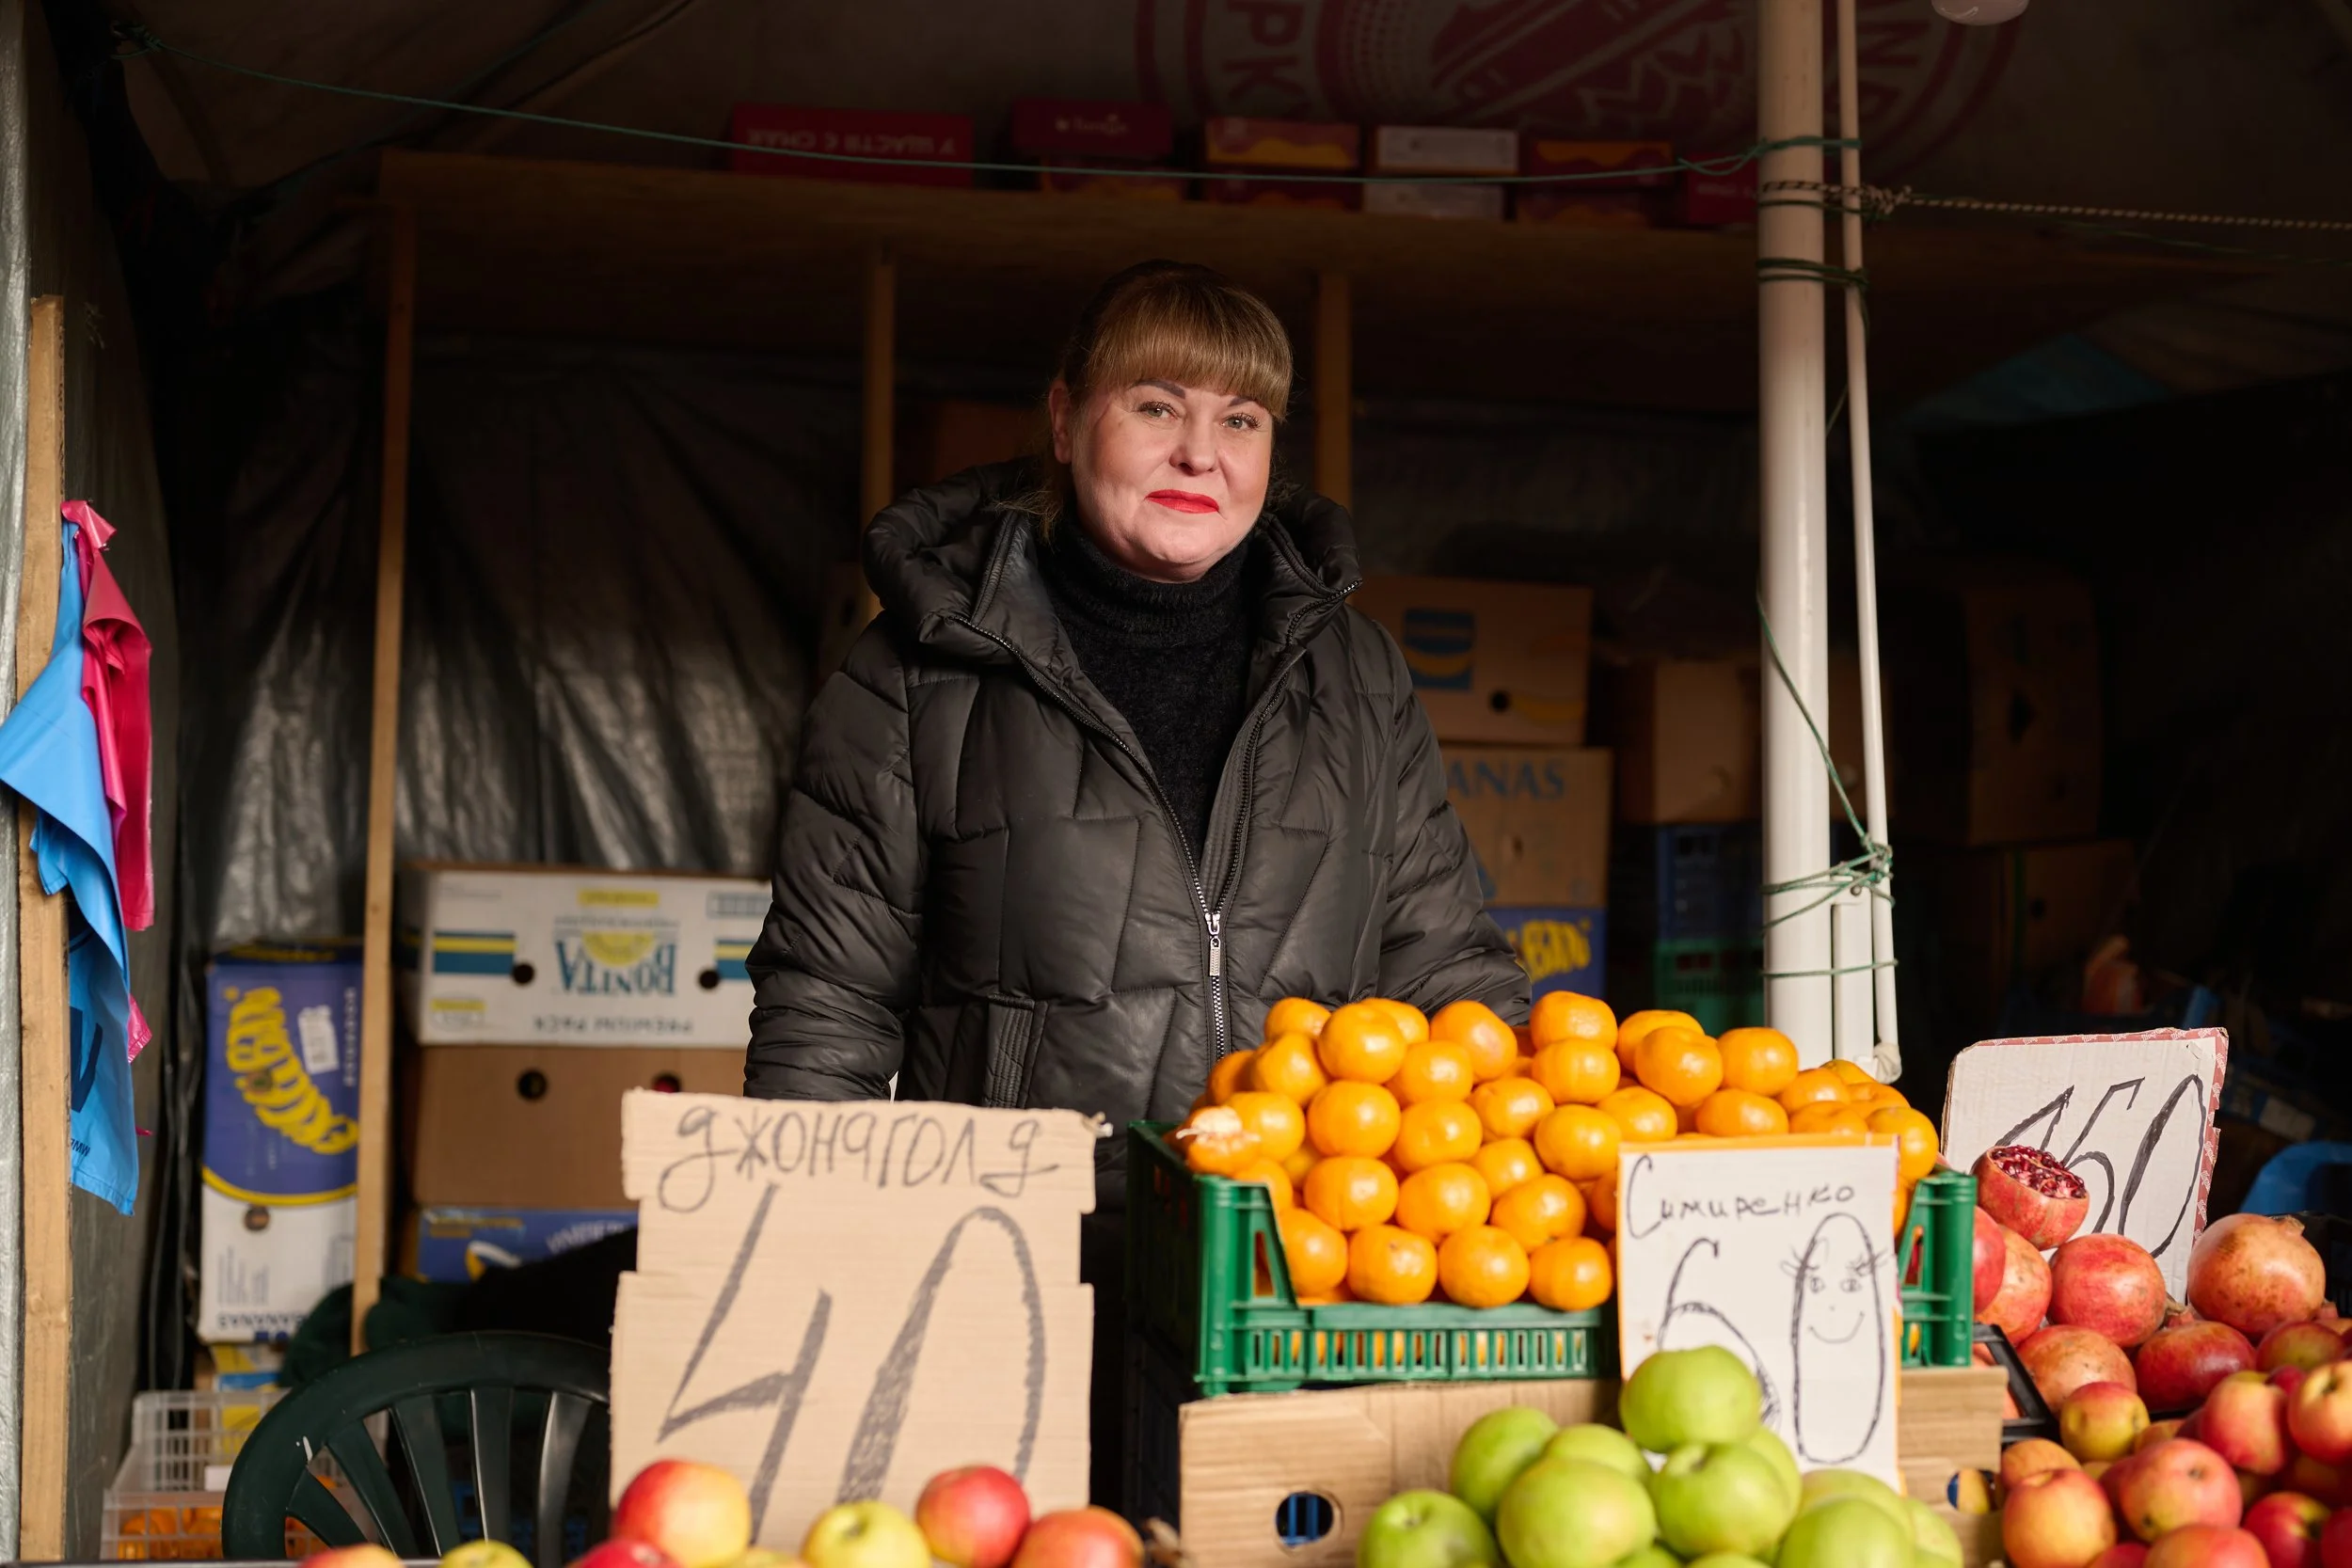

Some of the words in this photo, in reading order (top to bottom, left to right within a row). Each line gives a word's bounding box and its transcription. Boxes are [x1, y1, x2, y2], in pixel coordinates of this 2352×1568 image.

[1447, 759, 1565, 800] ANAS
[556, 940, 678, 997] BONITA
[532, 1015, 588, 1035] PACK
[595, 1016, 694, 1036] PREMIUM
[656, 1181, 1047, 1545] 40
[1656, 1212, 1885, 1465] 60
